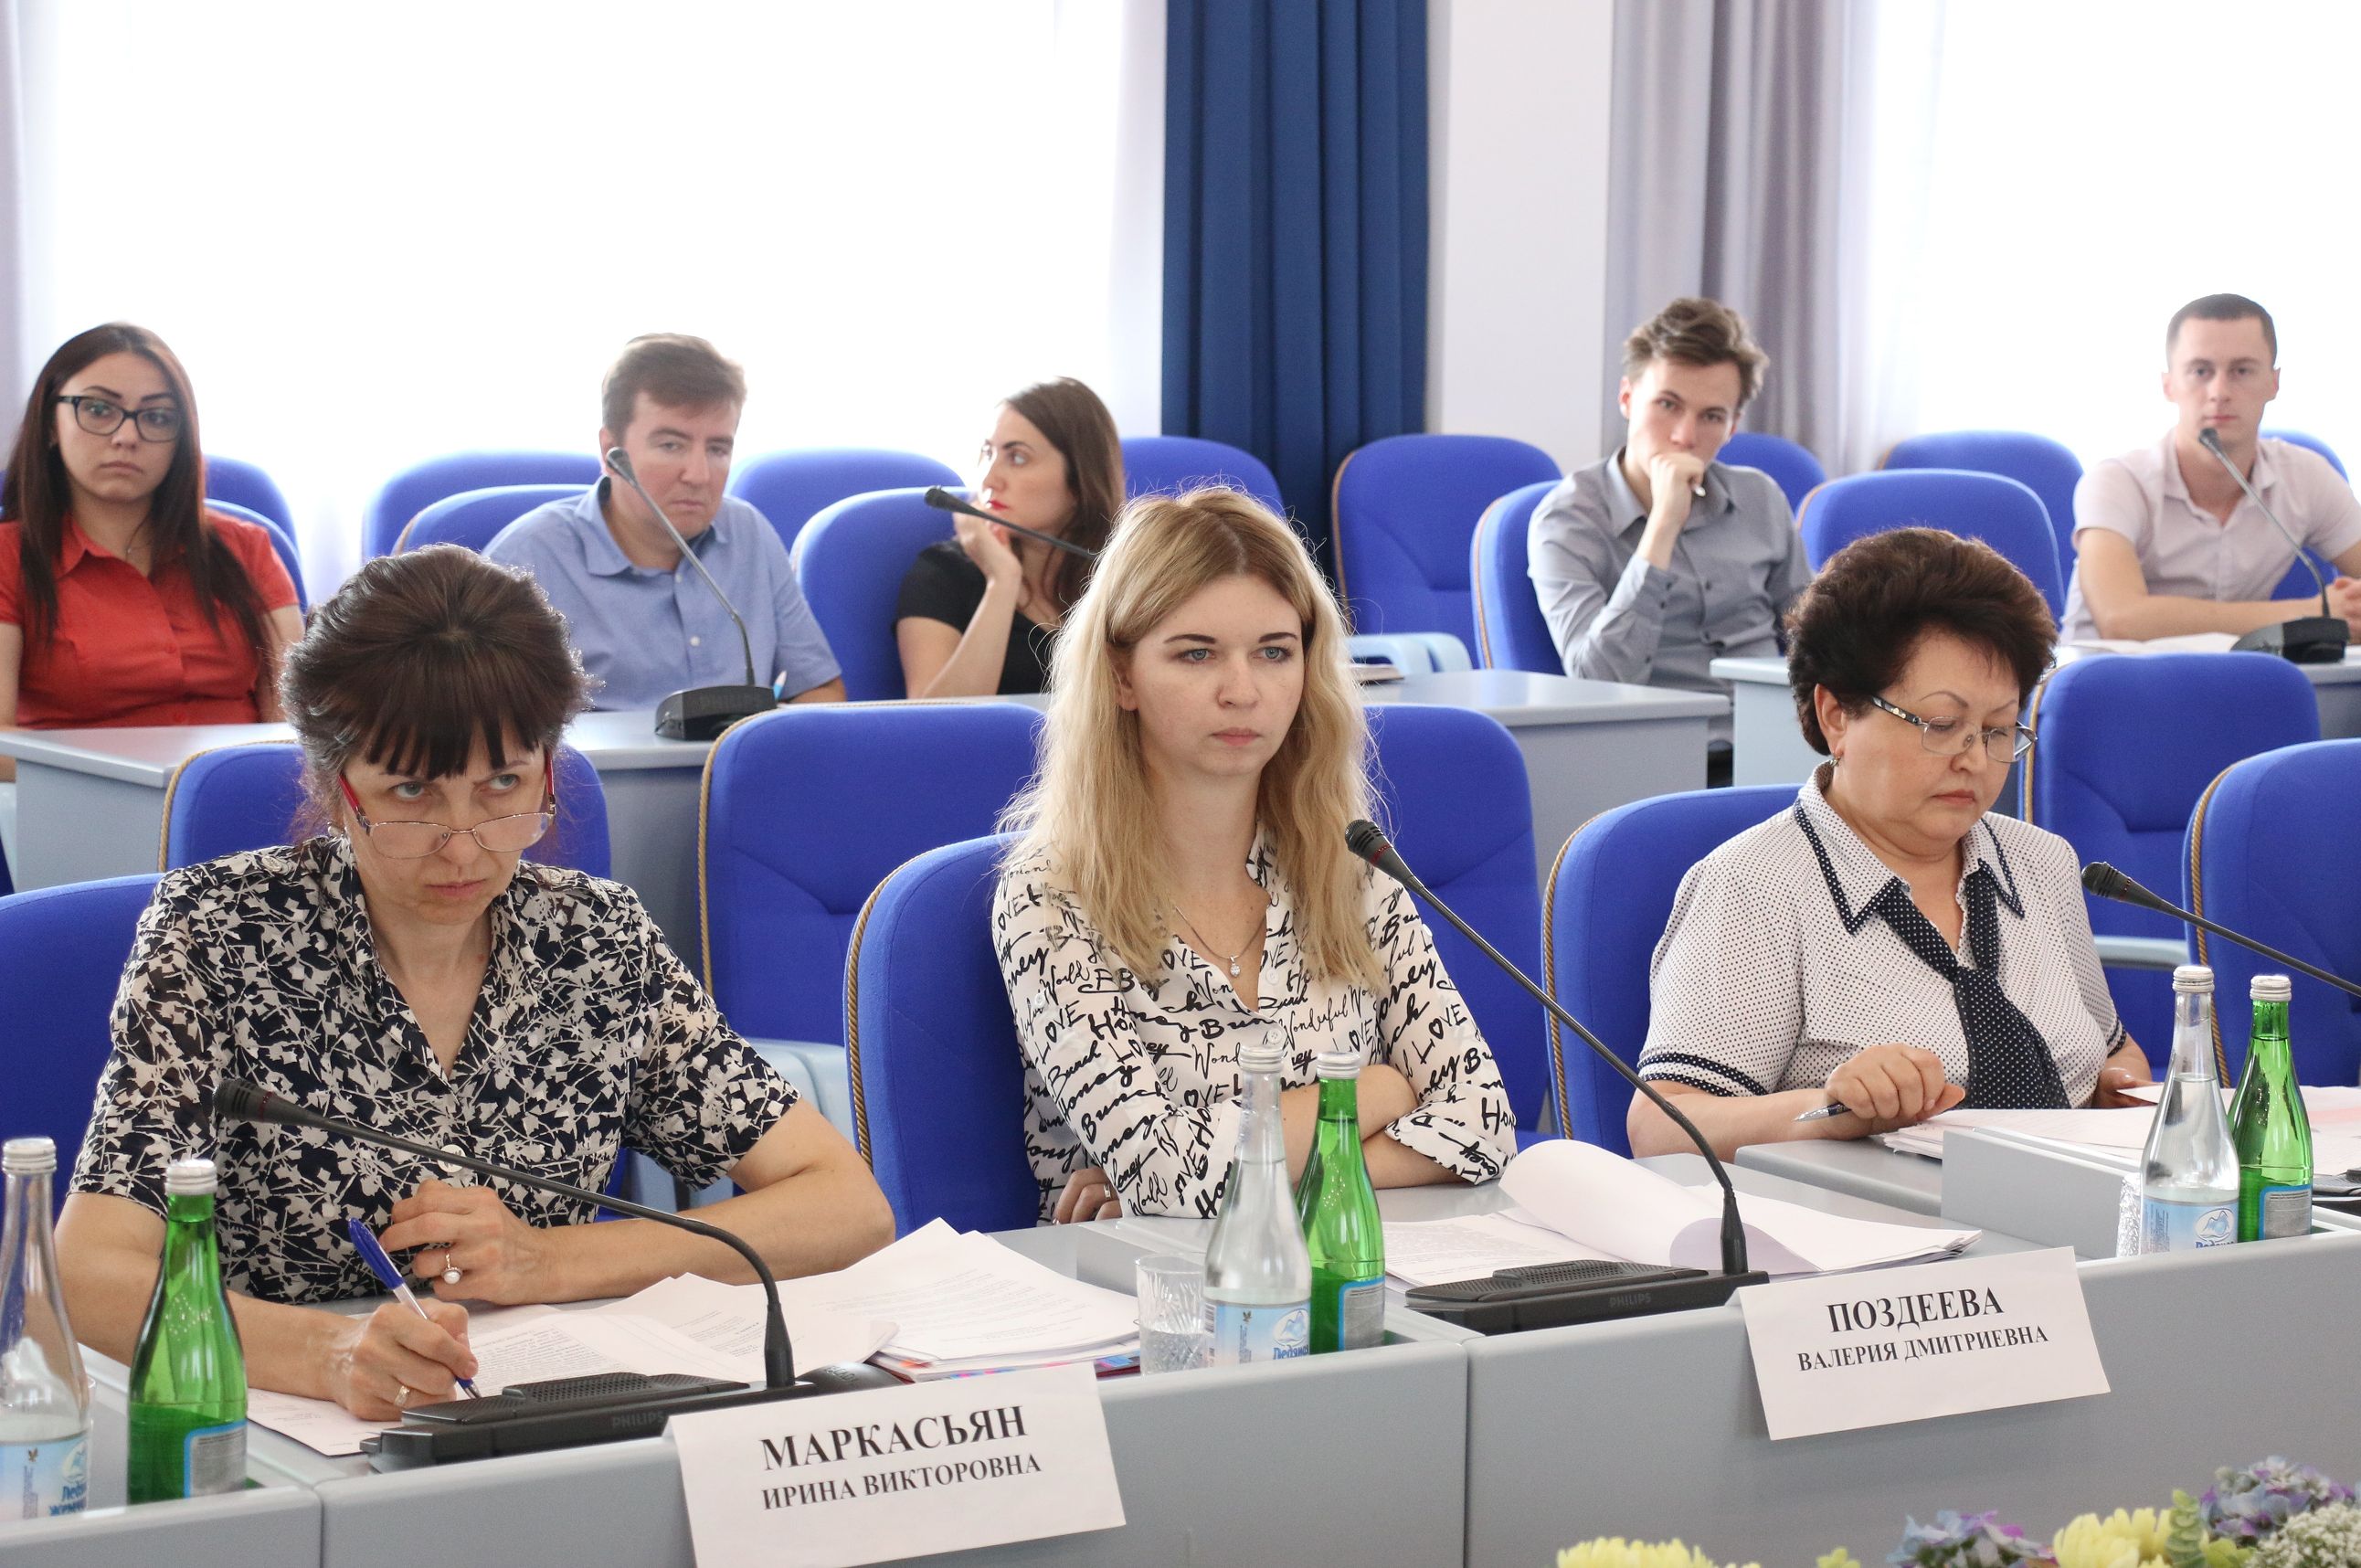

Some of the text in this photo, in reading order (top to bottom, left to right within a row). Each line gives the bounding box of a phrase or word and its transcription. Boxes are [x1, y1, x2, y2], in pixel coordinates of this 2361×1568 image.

[1379, 914, 1421, 950] Bun
[1161, 948, 1211, 970] OVE
[1035, 1000, 1086, 1065] LOVE
[1087, 1010, 1138, 1041] Hon
[1199, 1018, 1277, 1040] Bun
[1412, 1003, 1467, 1065] LOVE
[1183, 1083, 1230, 1108] OVE
[1608, 1291, 1652, 1309] PHILIPS
[1826, 1286, 2005, 1333] ПОЗДЕЕВА
[1796, 1325, 2049, 1372] ВАЛЕРИЯ ДМИТРИЕВНА
[610, 1409, 666, 1429] PHILIPS
[760, 1404, 1029, 1470] МАРКАСЬЯН
[761, 1453, 1043, 1510] ИРИНА ВИКТОРОВНА
